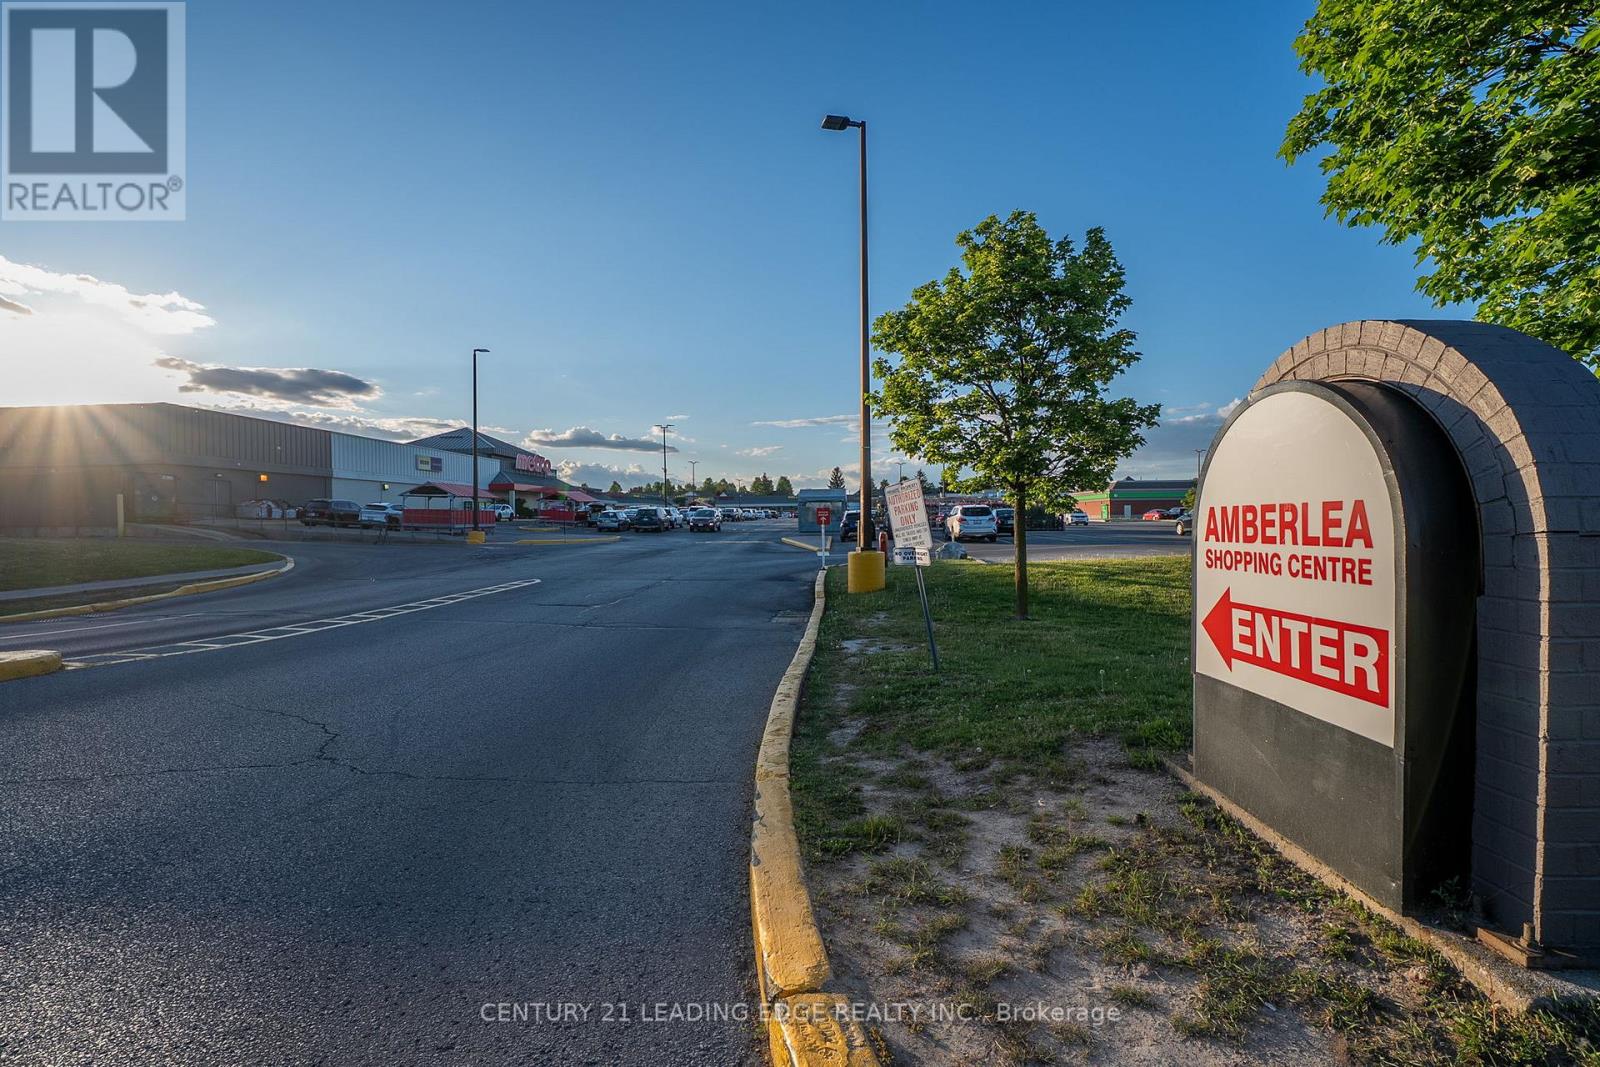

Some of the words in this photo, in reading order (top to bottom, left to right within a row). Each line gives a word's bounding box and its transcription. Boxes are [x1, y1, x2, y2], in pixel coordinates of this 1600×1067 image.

[888, 489, 920, 505] AUTHORIZED
[893, 501, 919, 517] PARKING
[900, 513, 917, 526] ONLY
[1204, 500, 1374, 549] AMBERLEA
[1205, 549, 1282, 576] SHOPPING
[1287, 553, 1373, 586] CENTRE
[1231, 607, 1380, 694] ENTER
